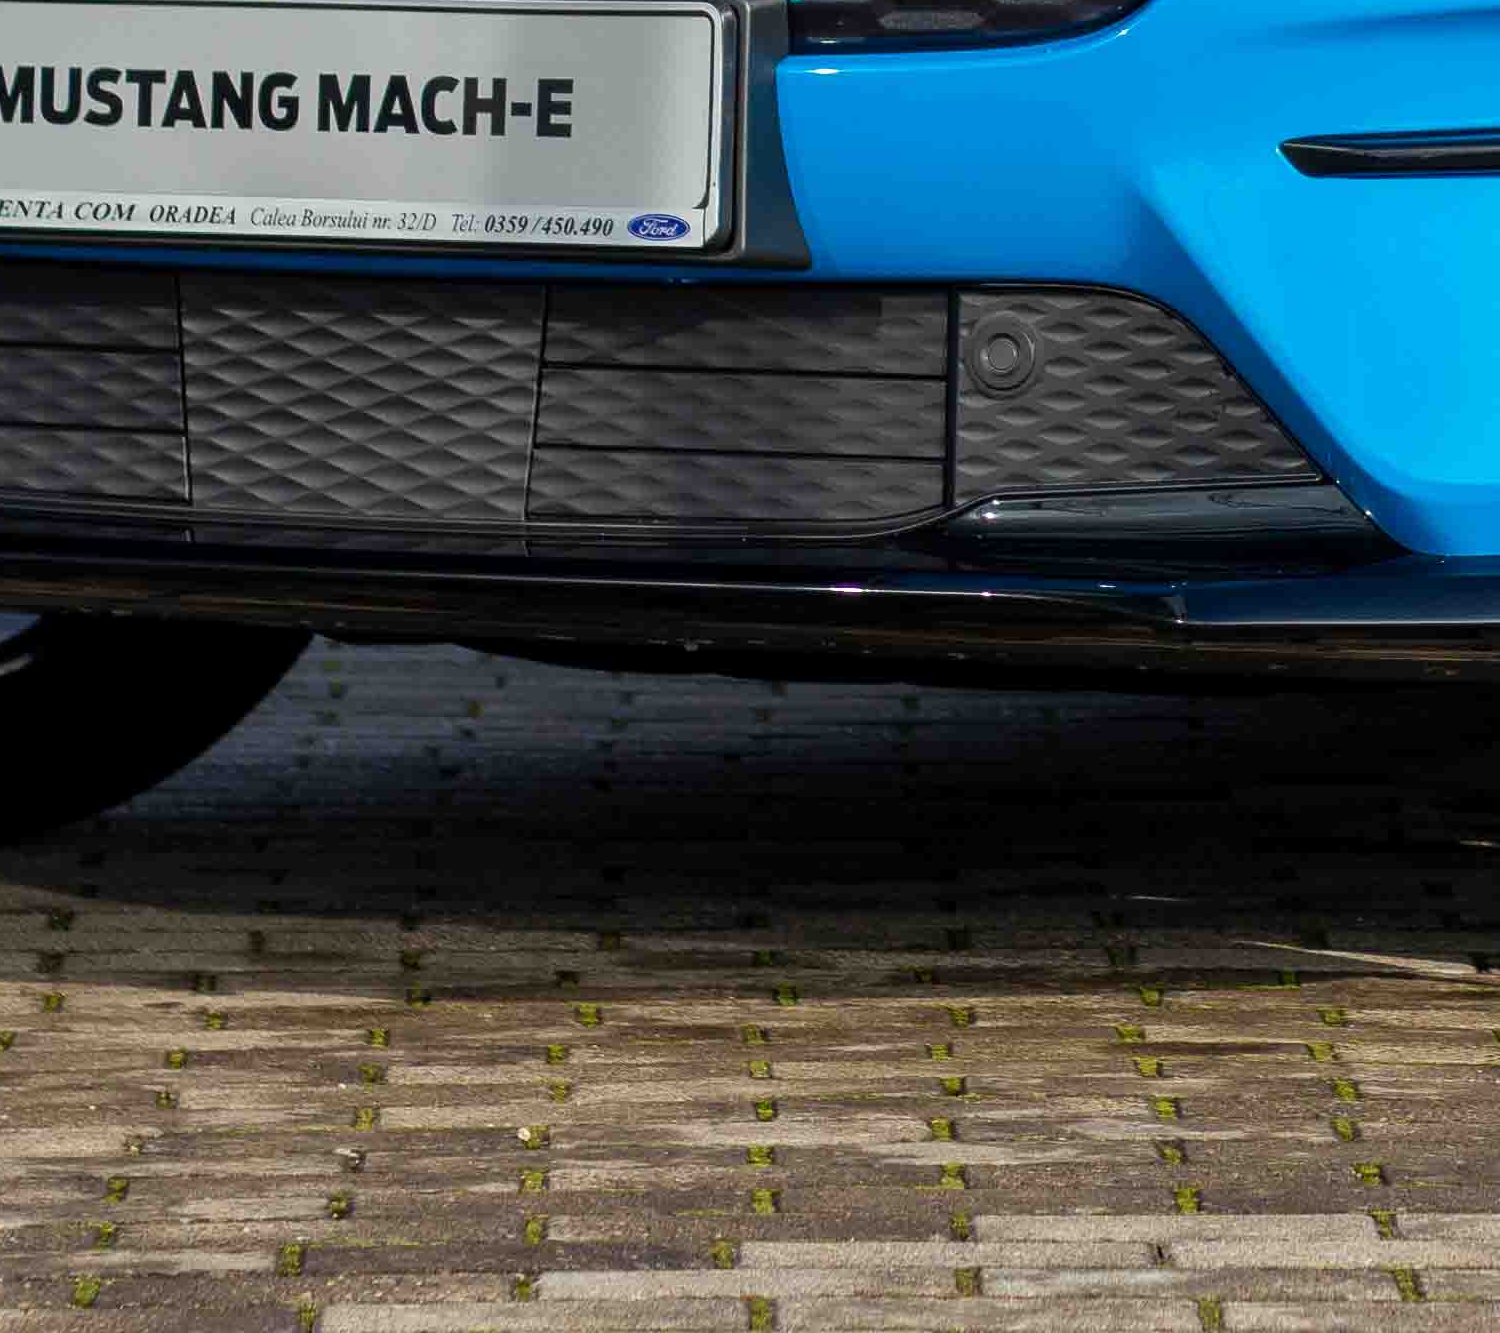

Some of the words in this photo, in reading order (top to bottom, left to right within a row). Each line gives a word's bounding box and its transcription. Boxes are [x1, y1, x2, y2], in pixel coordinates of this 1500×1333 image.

[317, 73, 574, 138] MACH-E
[74, 201, 137, 222] COM
[149, 204, 236, 226] ORADEA
[250, 206, 297, 227] Calea
[300, 208, 369, 230] Borsului
[397, 212, 437, 231] 32/D
[639, 218, 677, 236] Ford
